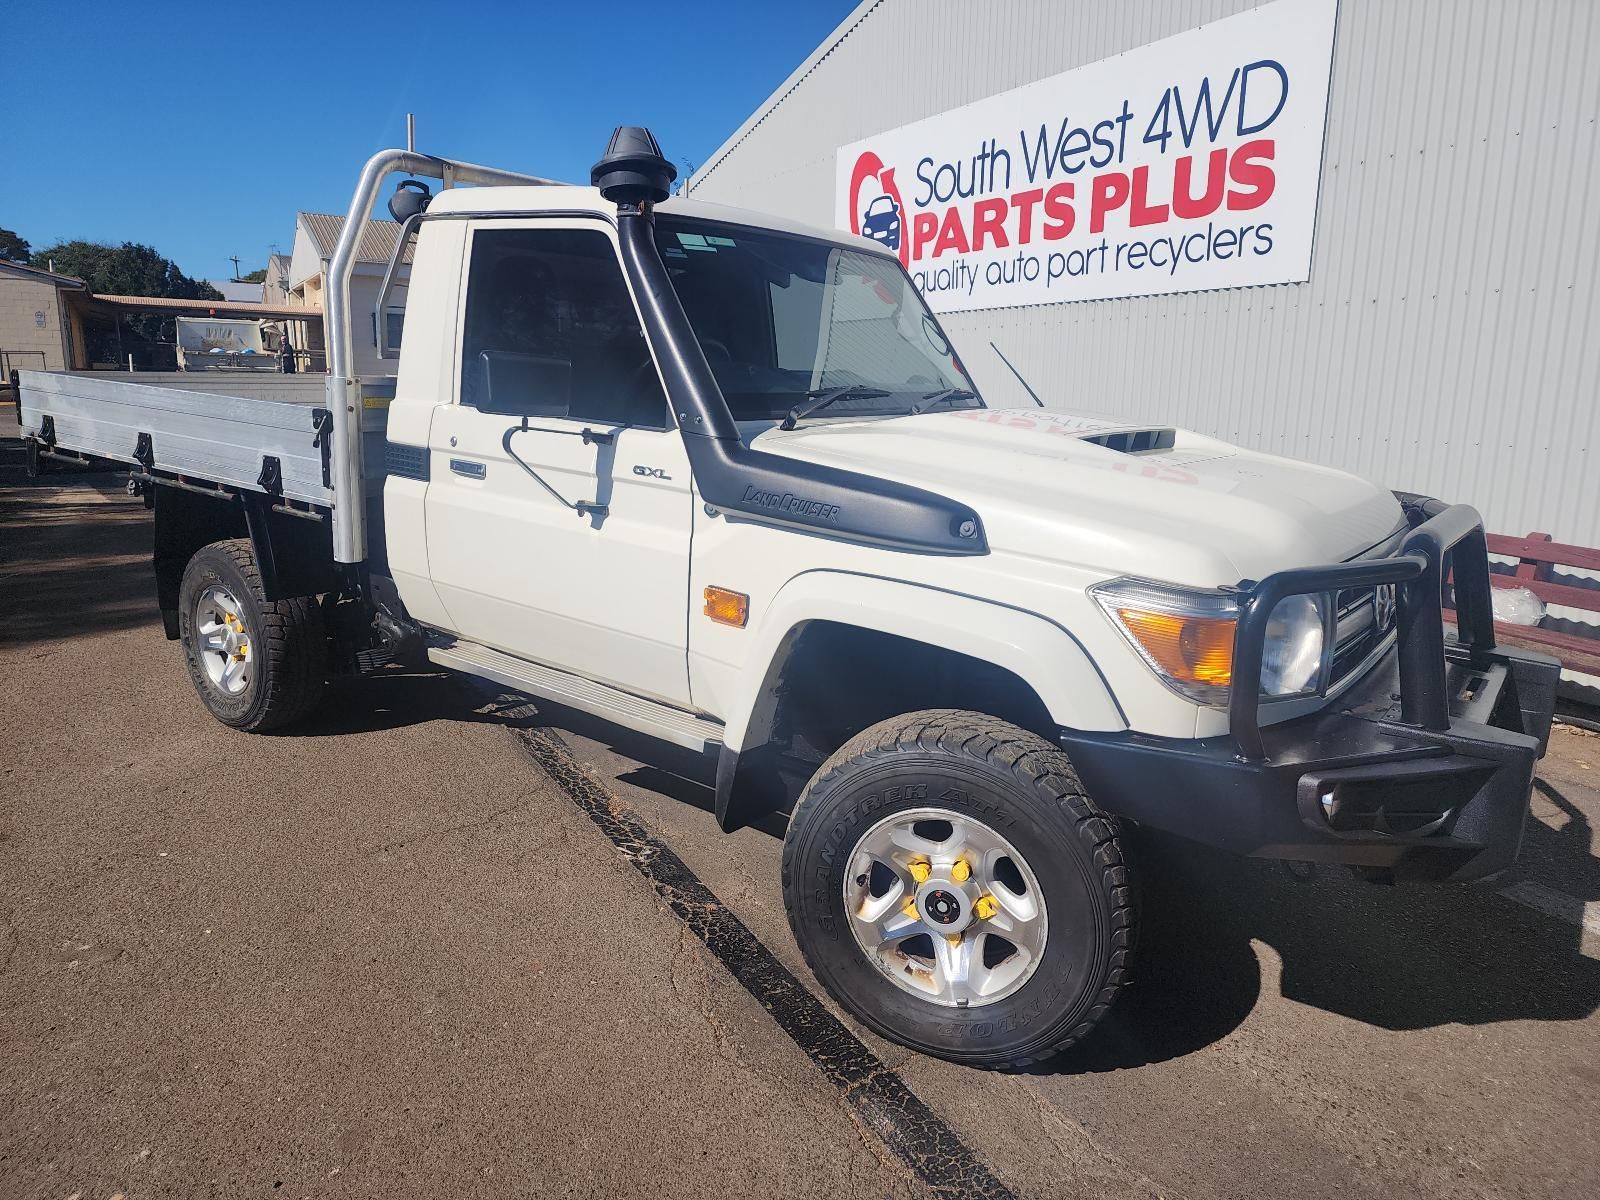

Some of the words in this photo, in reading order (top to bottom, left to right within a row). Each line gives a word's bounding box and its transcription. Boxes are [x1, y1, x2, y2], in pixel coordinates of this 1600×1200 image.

[914, 139, 1011, 207] South
[1020, 100, 1134, 183] West
[1142, 59, 1289, 153] 4WD
[912, 182, 1076, 261] PARTS
[1089, 139, 1276, 234] PLUS
[913, 258, 979, 297] quality
[985, 250, 1040, 286] auto
[1047, 236, 1108, 288] part
[1114, 223, 1274, 276] recyclers
[632, 464, 672, 481] GXL
